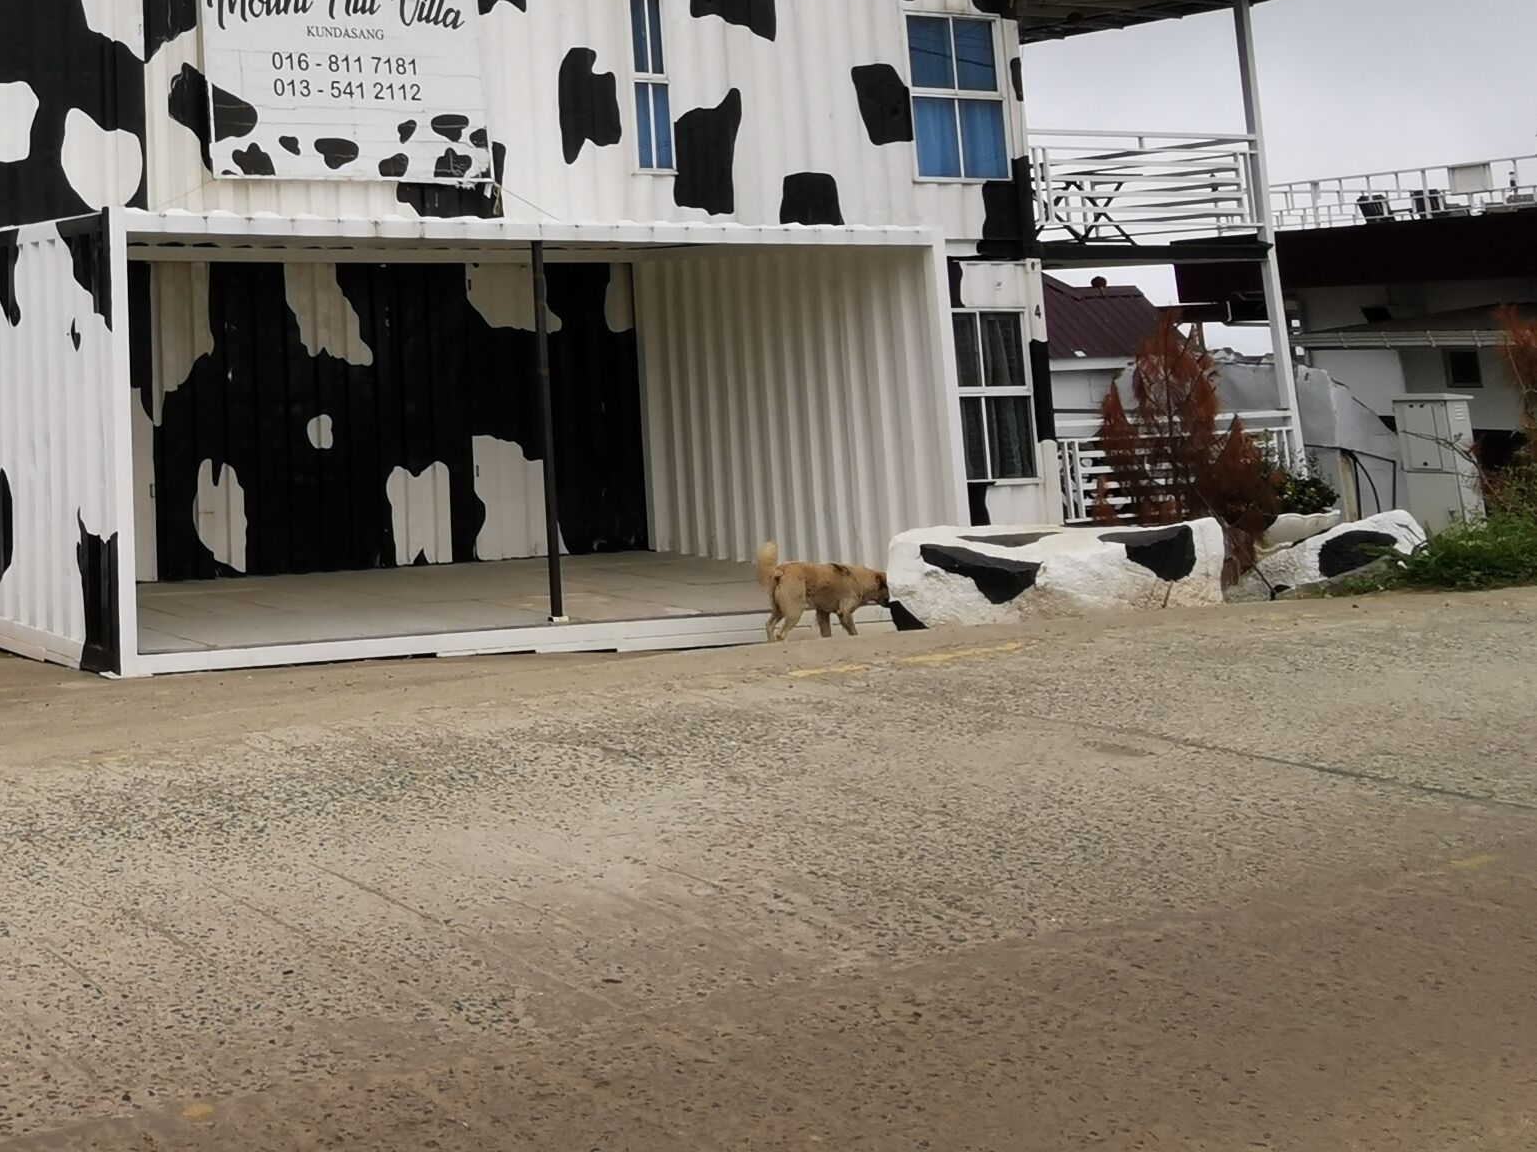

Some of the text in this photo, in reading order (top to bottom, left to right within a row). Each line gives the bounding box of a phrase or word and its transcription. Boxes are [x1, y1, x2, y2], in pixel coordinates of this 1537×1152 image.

[306, 25, 385, 41] KUNDASANG
[272, 51, 310, 72] 016
[328, 54, 363, 74] 811
[371, 56, 418, 76] 7181
[273, 78, 311, 98] 013
[330, 80, 364, 100] 541
[373, 82, 422, 102] 2112
